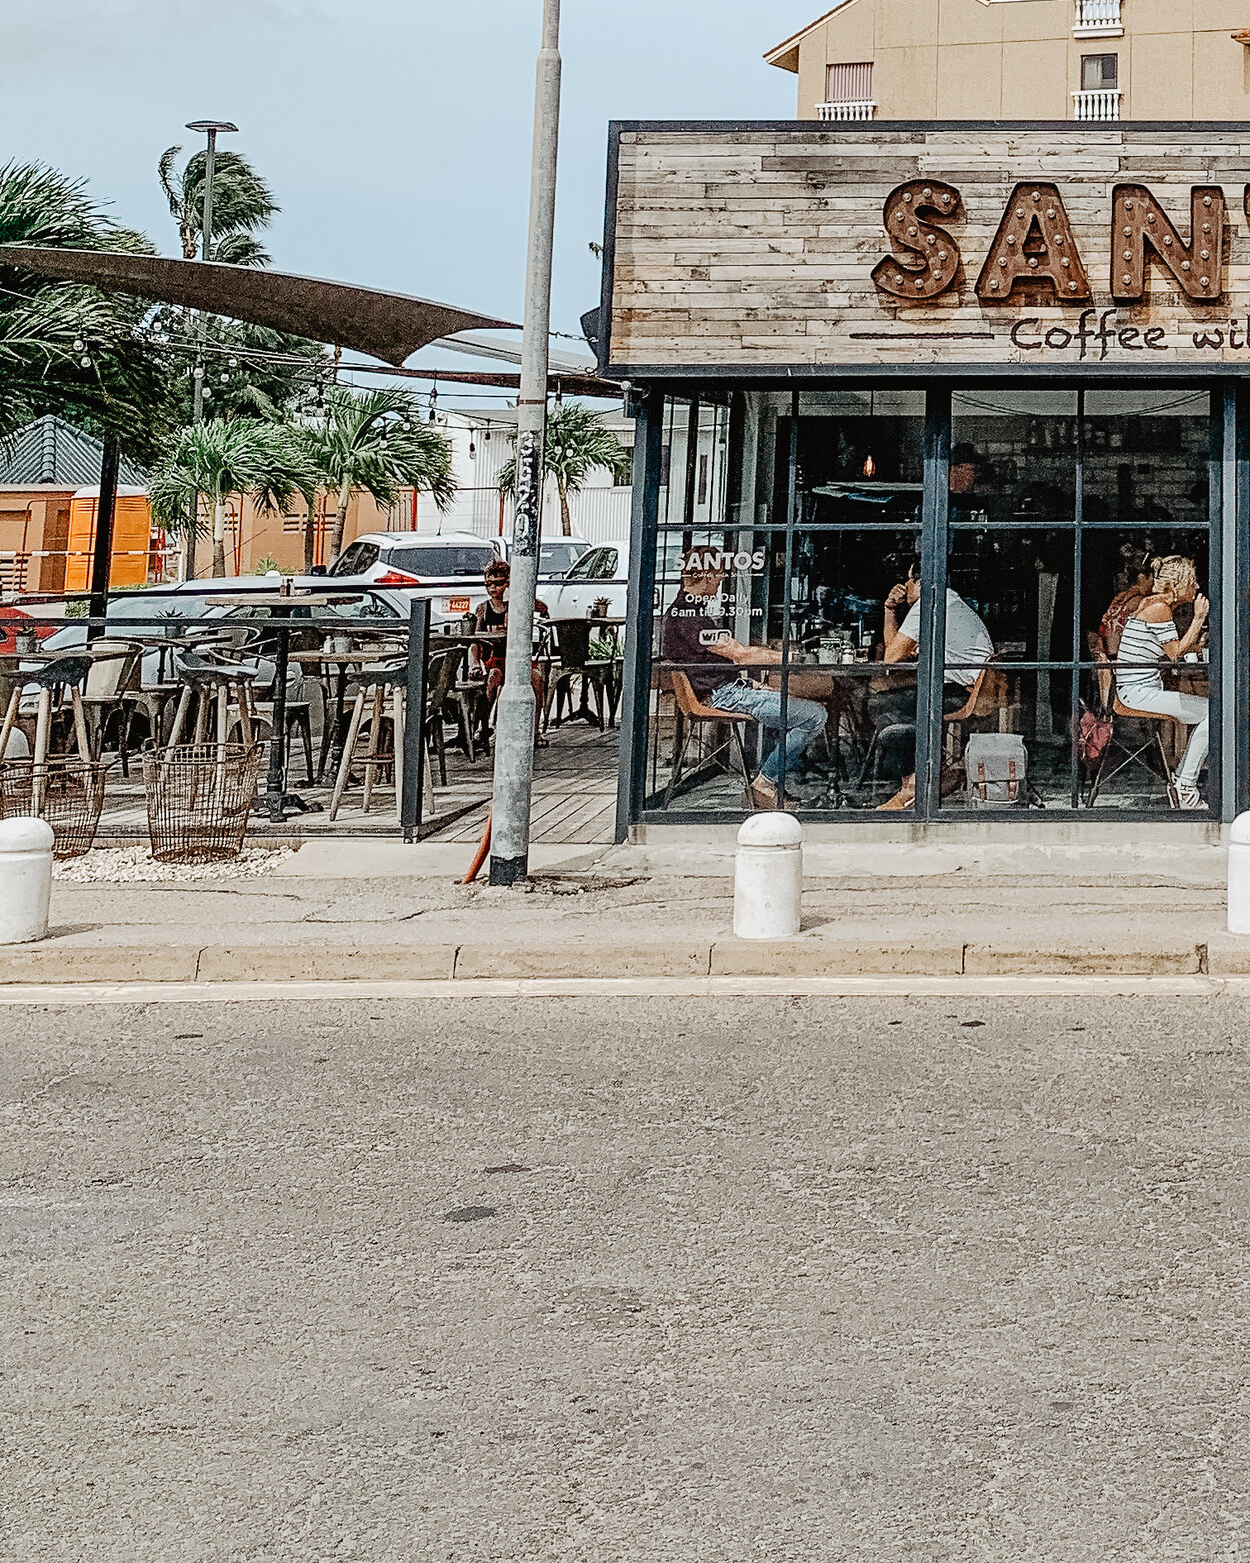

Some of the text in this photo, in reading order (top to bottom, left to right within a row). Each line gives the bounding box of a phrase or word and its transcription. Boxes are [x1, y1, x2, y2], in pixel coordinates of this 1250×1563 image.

[1010, 309, 1169, 361] Coffee
[674, 551, 764, 571] SANTOS
[685, 592, 750, 606] Open Daily
[671, 606, 696, 617] 6am
[718, 606, 763, 619] 9.30pm
